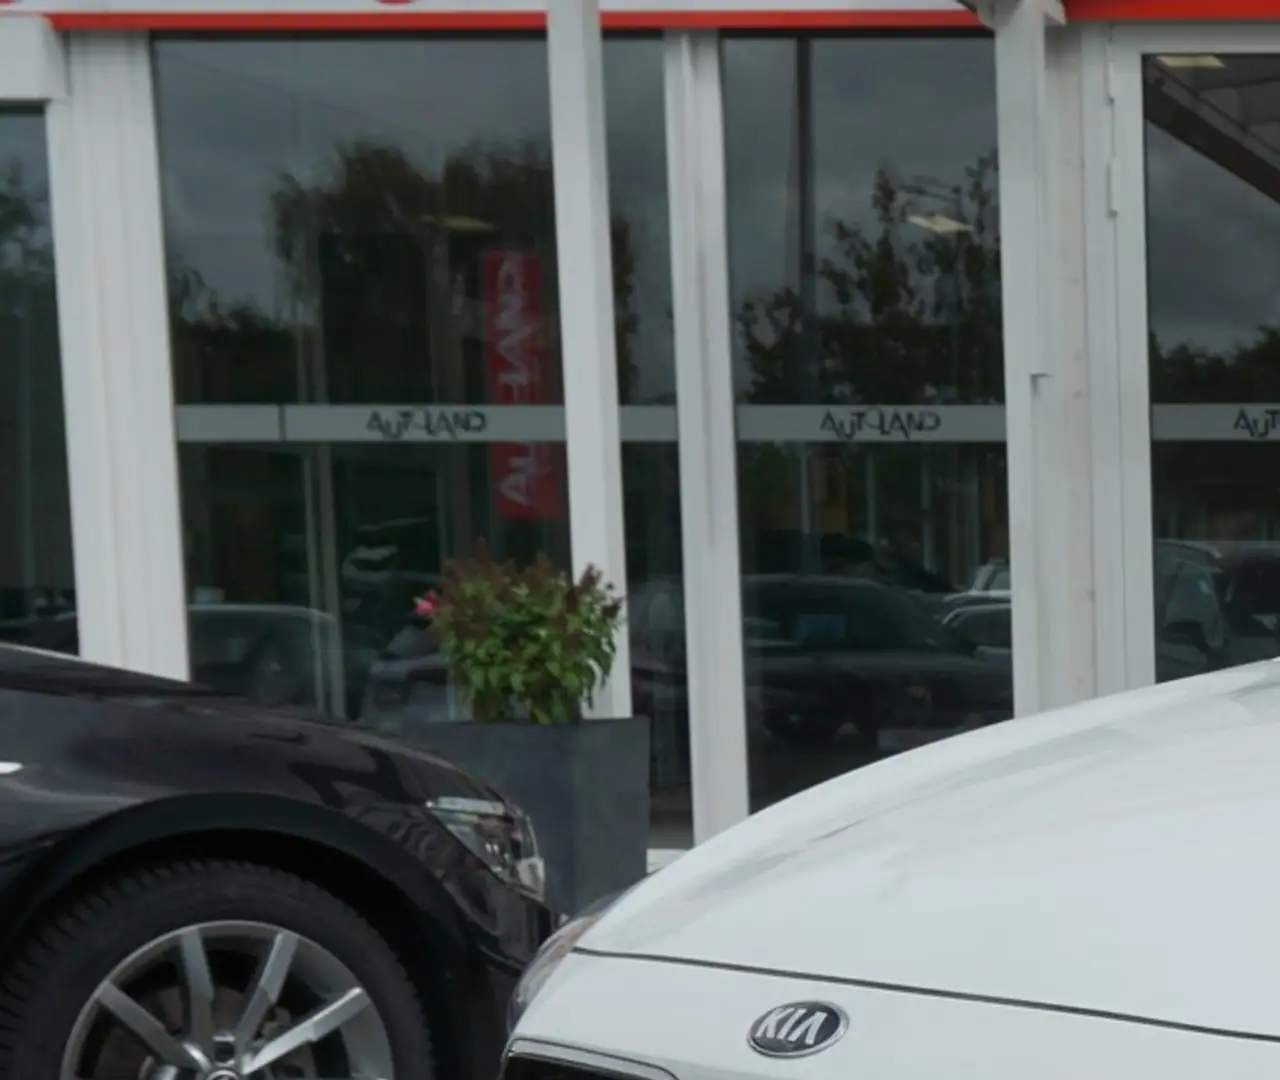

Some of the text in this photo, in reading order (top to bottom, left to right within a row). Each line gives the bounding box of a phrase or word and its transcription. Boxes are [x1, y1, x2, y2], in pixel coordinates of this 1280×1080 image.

[366, 406, 488, 441] AUTOLAND
[819, 403, 942, 441] AUTOLAND
[754, 1006, 828, 1046] KIA
